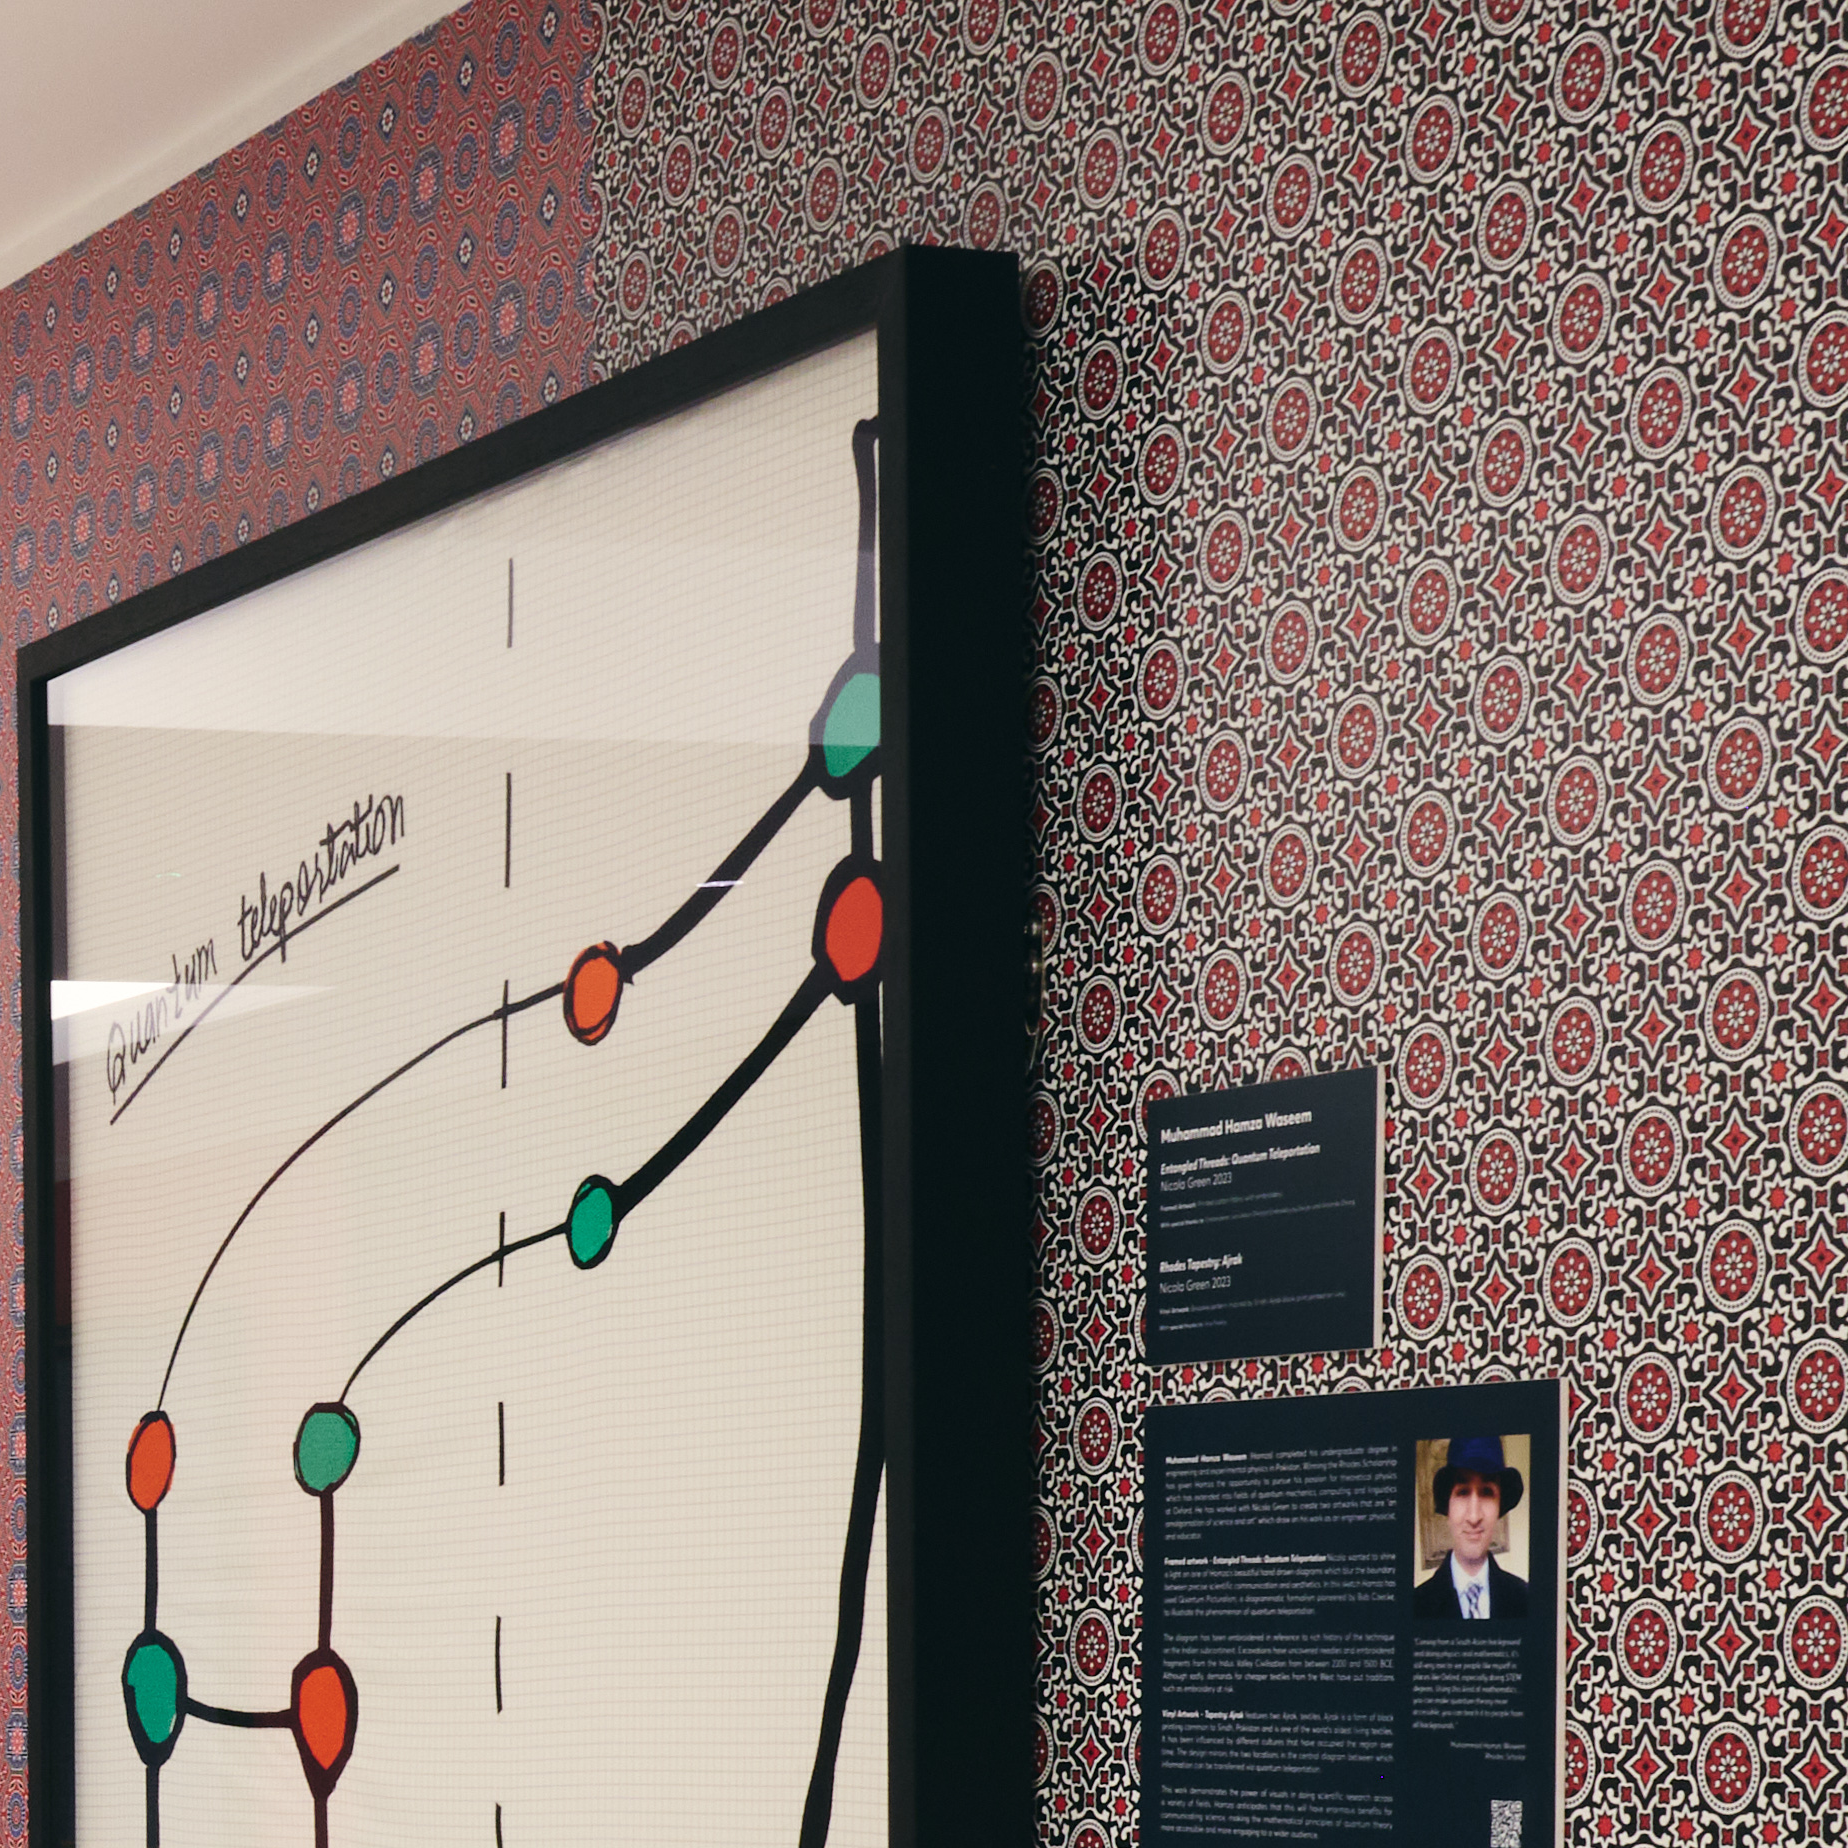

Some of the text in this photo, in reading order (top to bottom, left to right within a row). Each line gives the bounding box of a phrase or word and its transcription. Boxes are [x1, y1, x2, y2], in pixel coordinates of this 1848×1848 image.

[237, 794, 405, 963] teleportation
[1161, 1111, 1312, 1143] Muhammad Hamza Waseem
[1161, 1171, 1232, 1191] Nicola Green 2023
[1160, 1276, 1231, 1293] Nicola Green 2023
